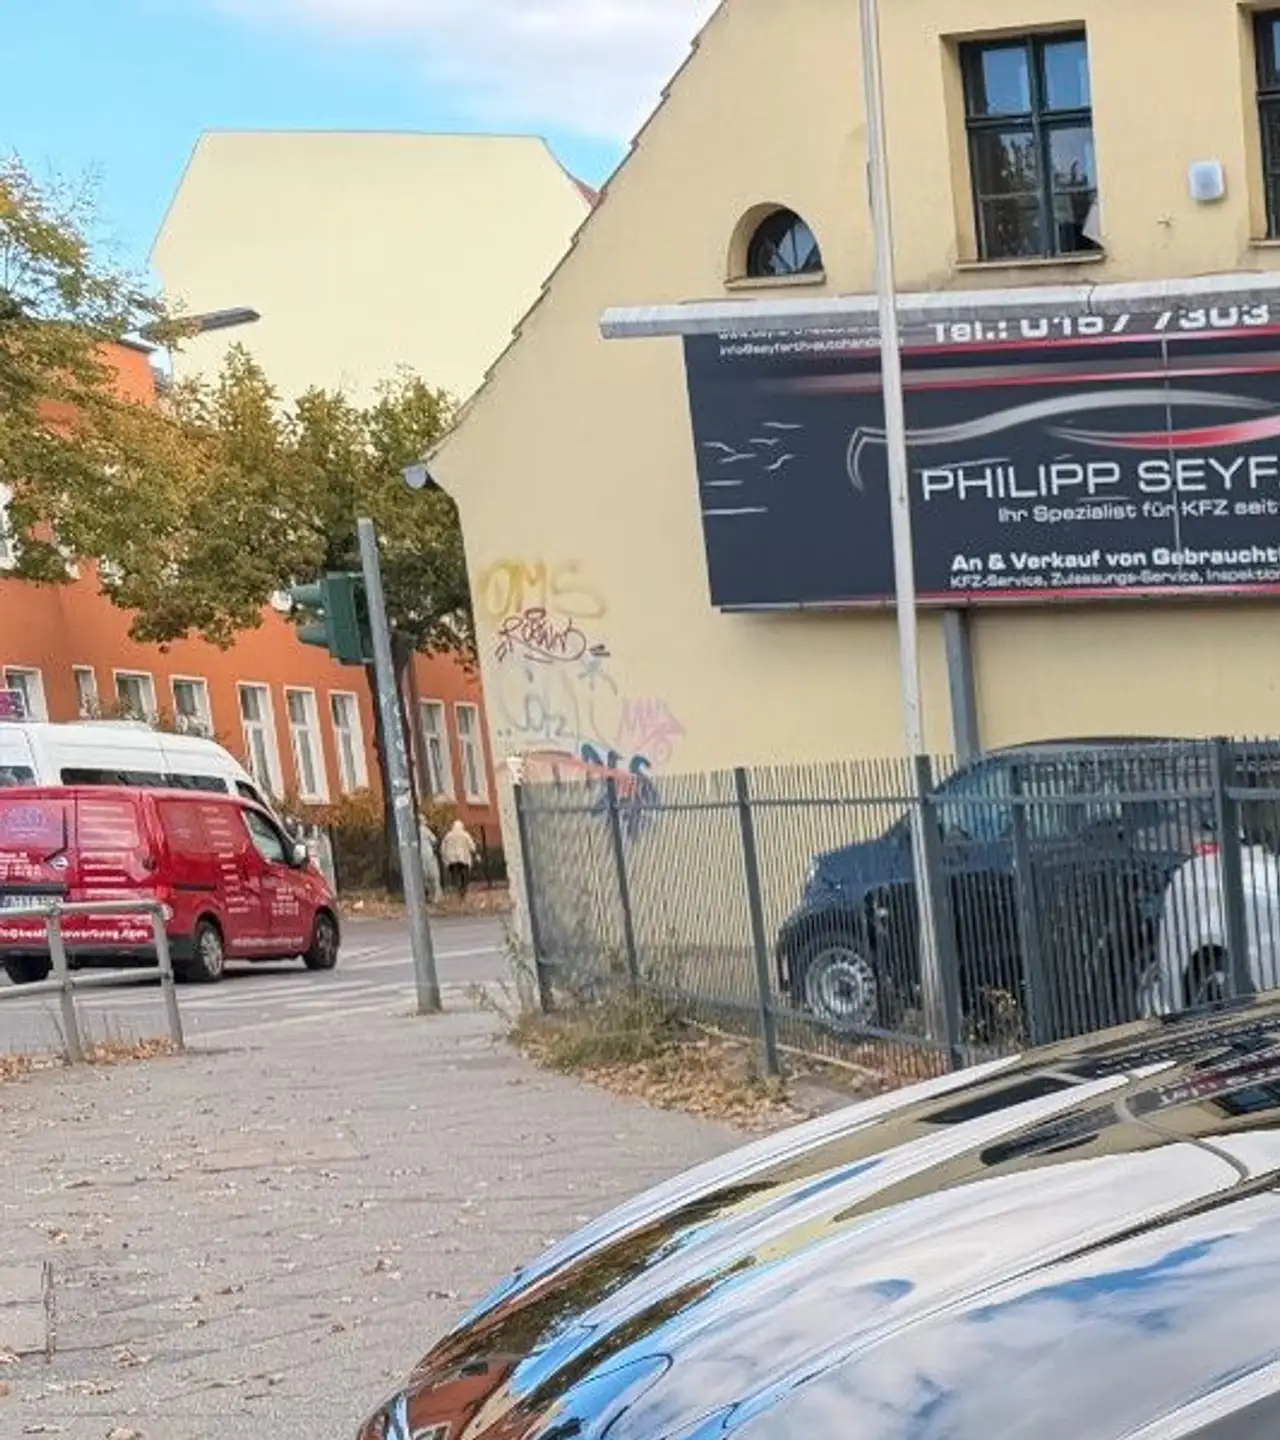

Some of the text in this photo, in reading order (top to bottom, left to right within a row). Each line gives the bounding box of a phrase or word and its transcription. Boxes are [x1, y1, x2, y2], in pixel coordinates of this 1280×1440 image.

[921, 461, 1121, 501] PHILIPP
[998, 507, 1029, 523] Ihr
[1033, 503, 1137, 524] Spezialist
[1142, 501, 1178, 519] für
[1181, 499, 1229, 517] KFZ
[1234, 499, 1279, 516] seit
[950, 555, 982, 572] An
[988, 553, 1007, 570] &
[1009, 550, 1100, 570] Verkauf
[1106, 551, 1147, 567] von
[950, 573, 1048, 590] KFZ-Service,
